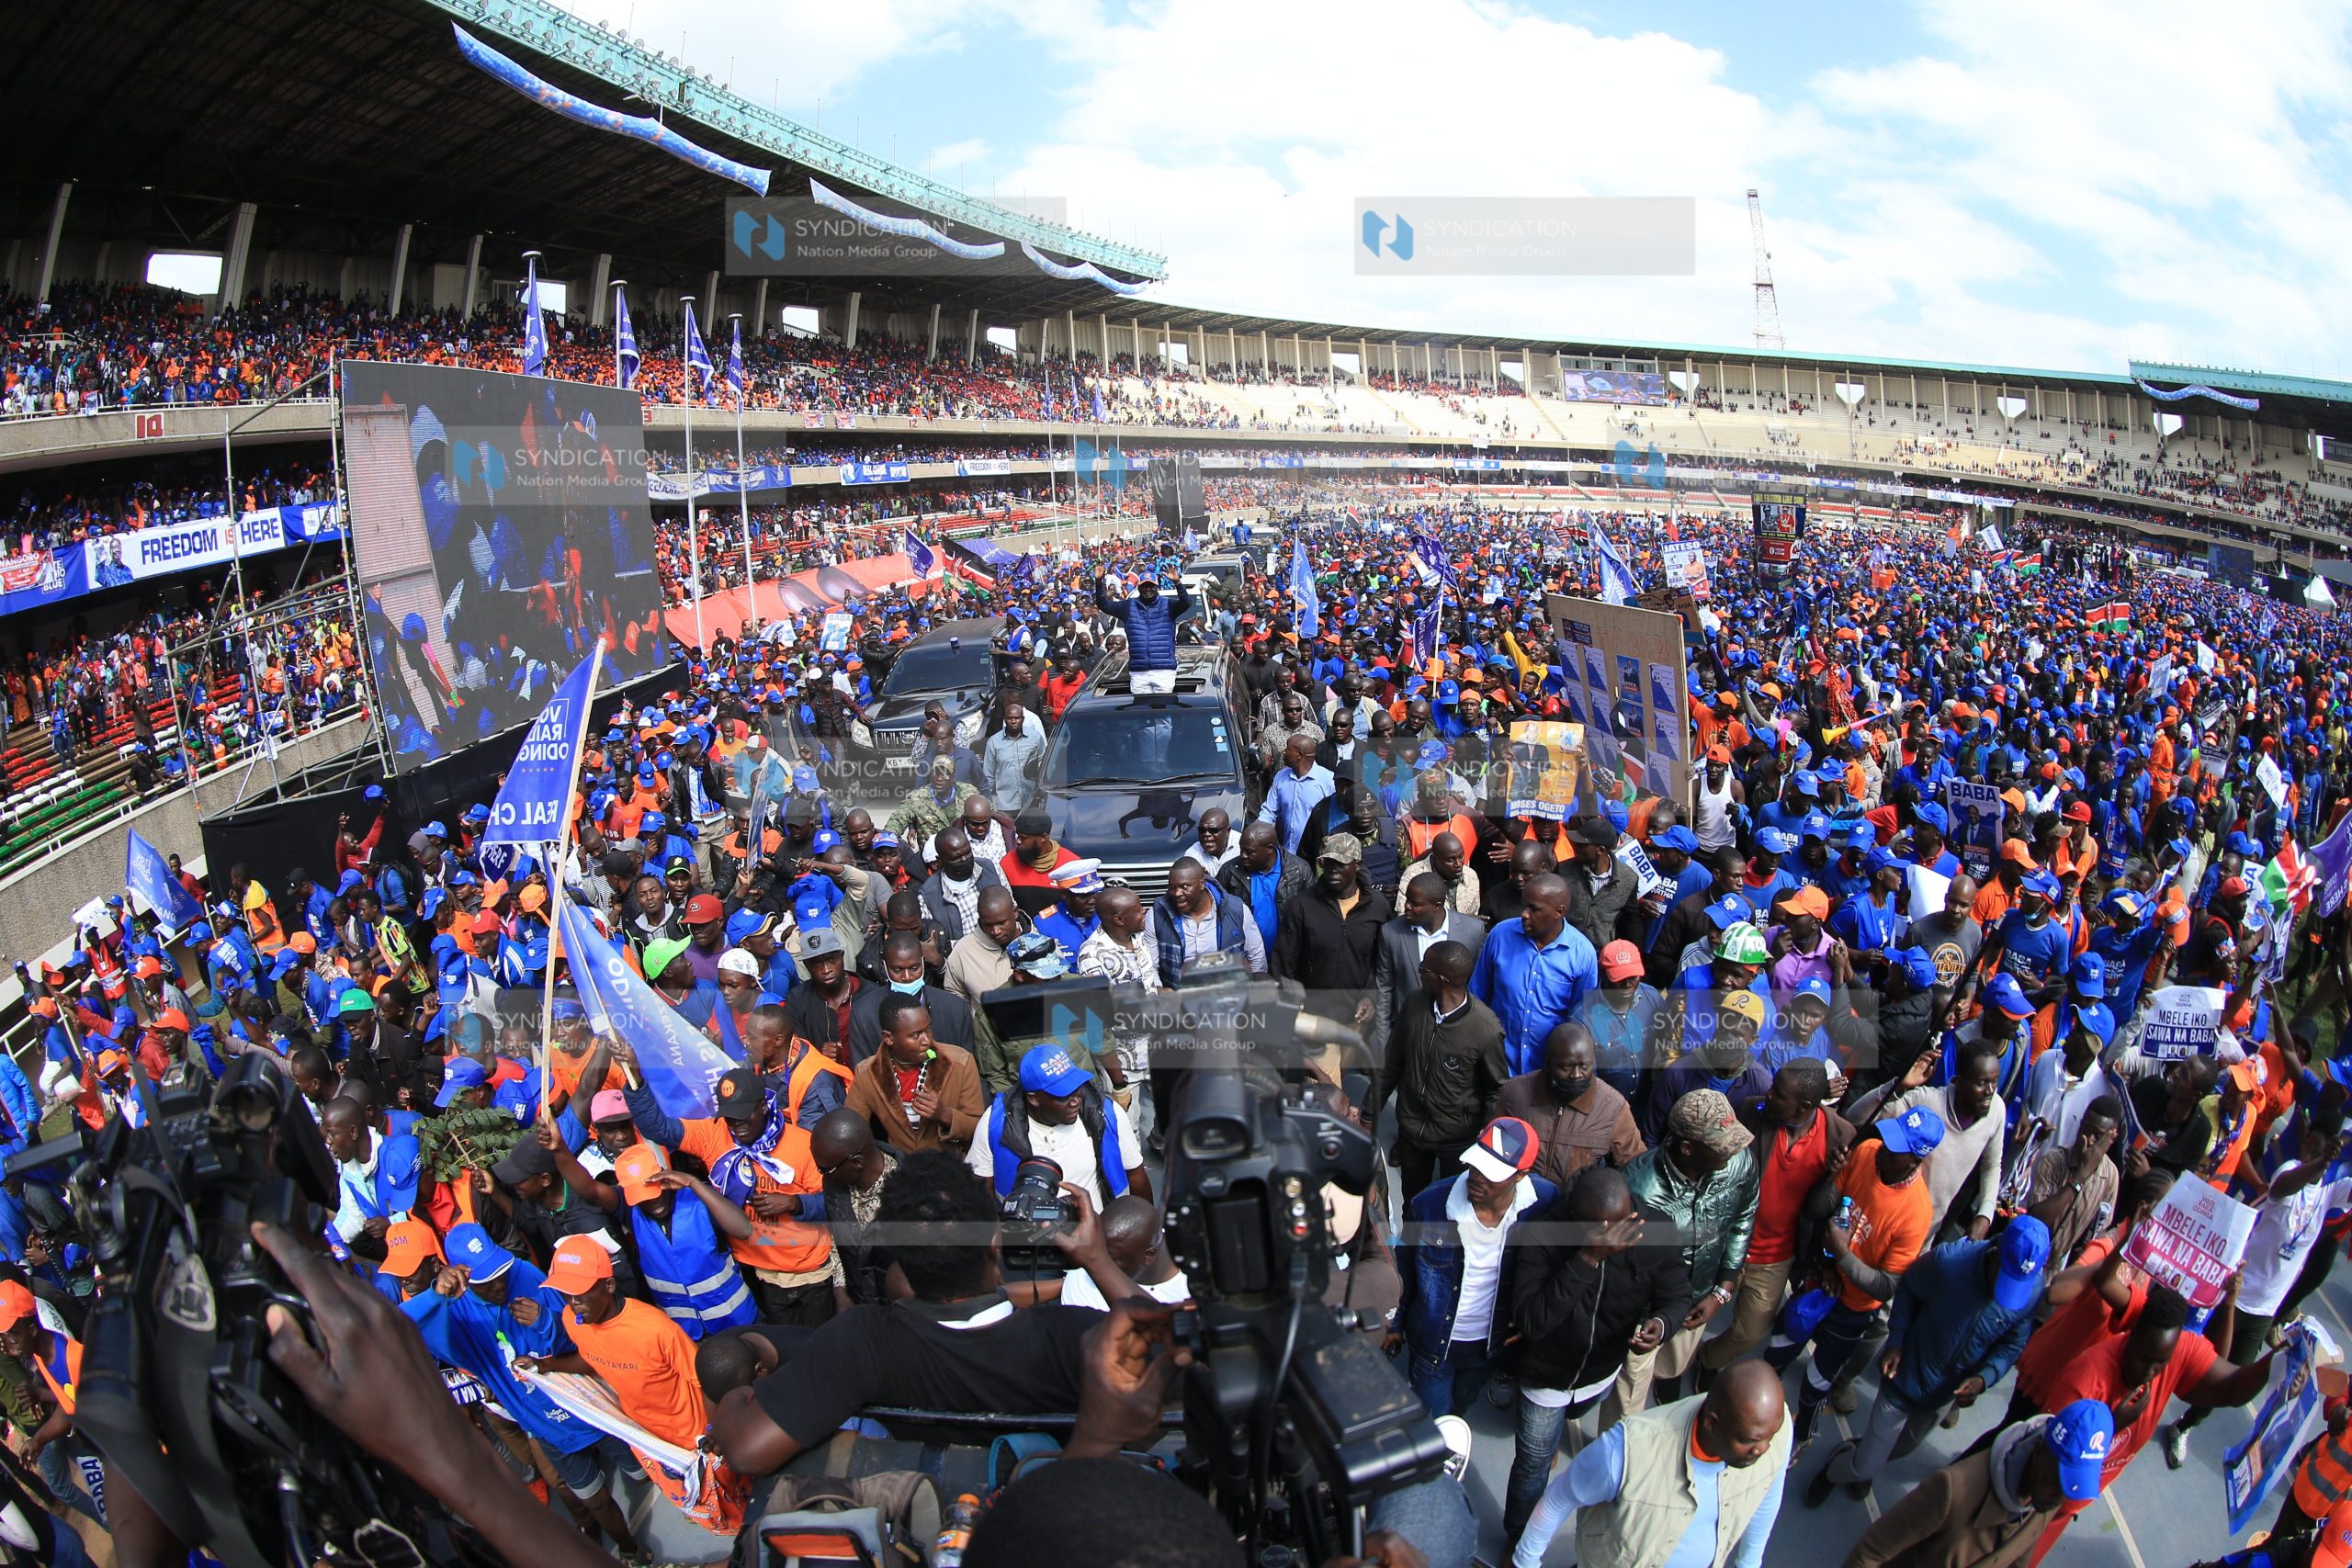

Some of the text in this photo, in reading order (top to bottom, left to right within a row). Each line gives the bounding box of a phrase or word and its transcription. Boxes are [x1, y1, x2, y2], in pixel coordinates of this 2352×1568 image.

[969, 461, 992, 471] FREEDOM
[998, 461, 1010, 471] HERE
[141, 517, 280, 566] FREEDOM IS HERE
[1664, 541, 1701, 552] JATESO
[888, 757, 904, 768] KBY
[1951, 782, 1997, 803] BABA
[1510, 799, 1566, 813] MOSES OGETO
[1546, 812, 1564, 820] WARD
[1781, 832, 1799, 842] ABA
[1628, 845, 1656, 884] BABA
[1658, 876, 1679, 889] ABA
[1650, 887, 1674, 900] ARTHA
[1754, 908, 1770, 919] BA
[2158, 1010, 2208, 1027] MBELE IKO
[2146, 1024, 2214, 1043] SAWA NA BABA
[1040, 1050, 1065, 1070] BABA
[1851, 1207, 1873, 1239] ABA
[2161, 1204, 2228, 1258] MBELE IKO
[389, 1236, 409, 1248] ODM
[2140, 1219, 2228, 1289] SAWA NA BABA
[605, 1359, 639, 1371] TAYARI
